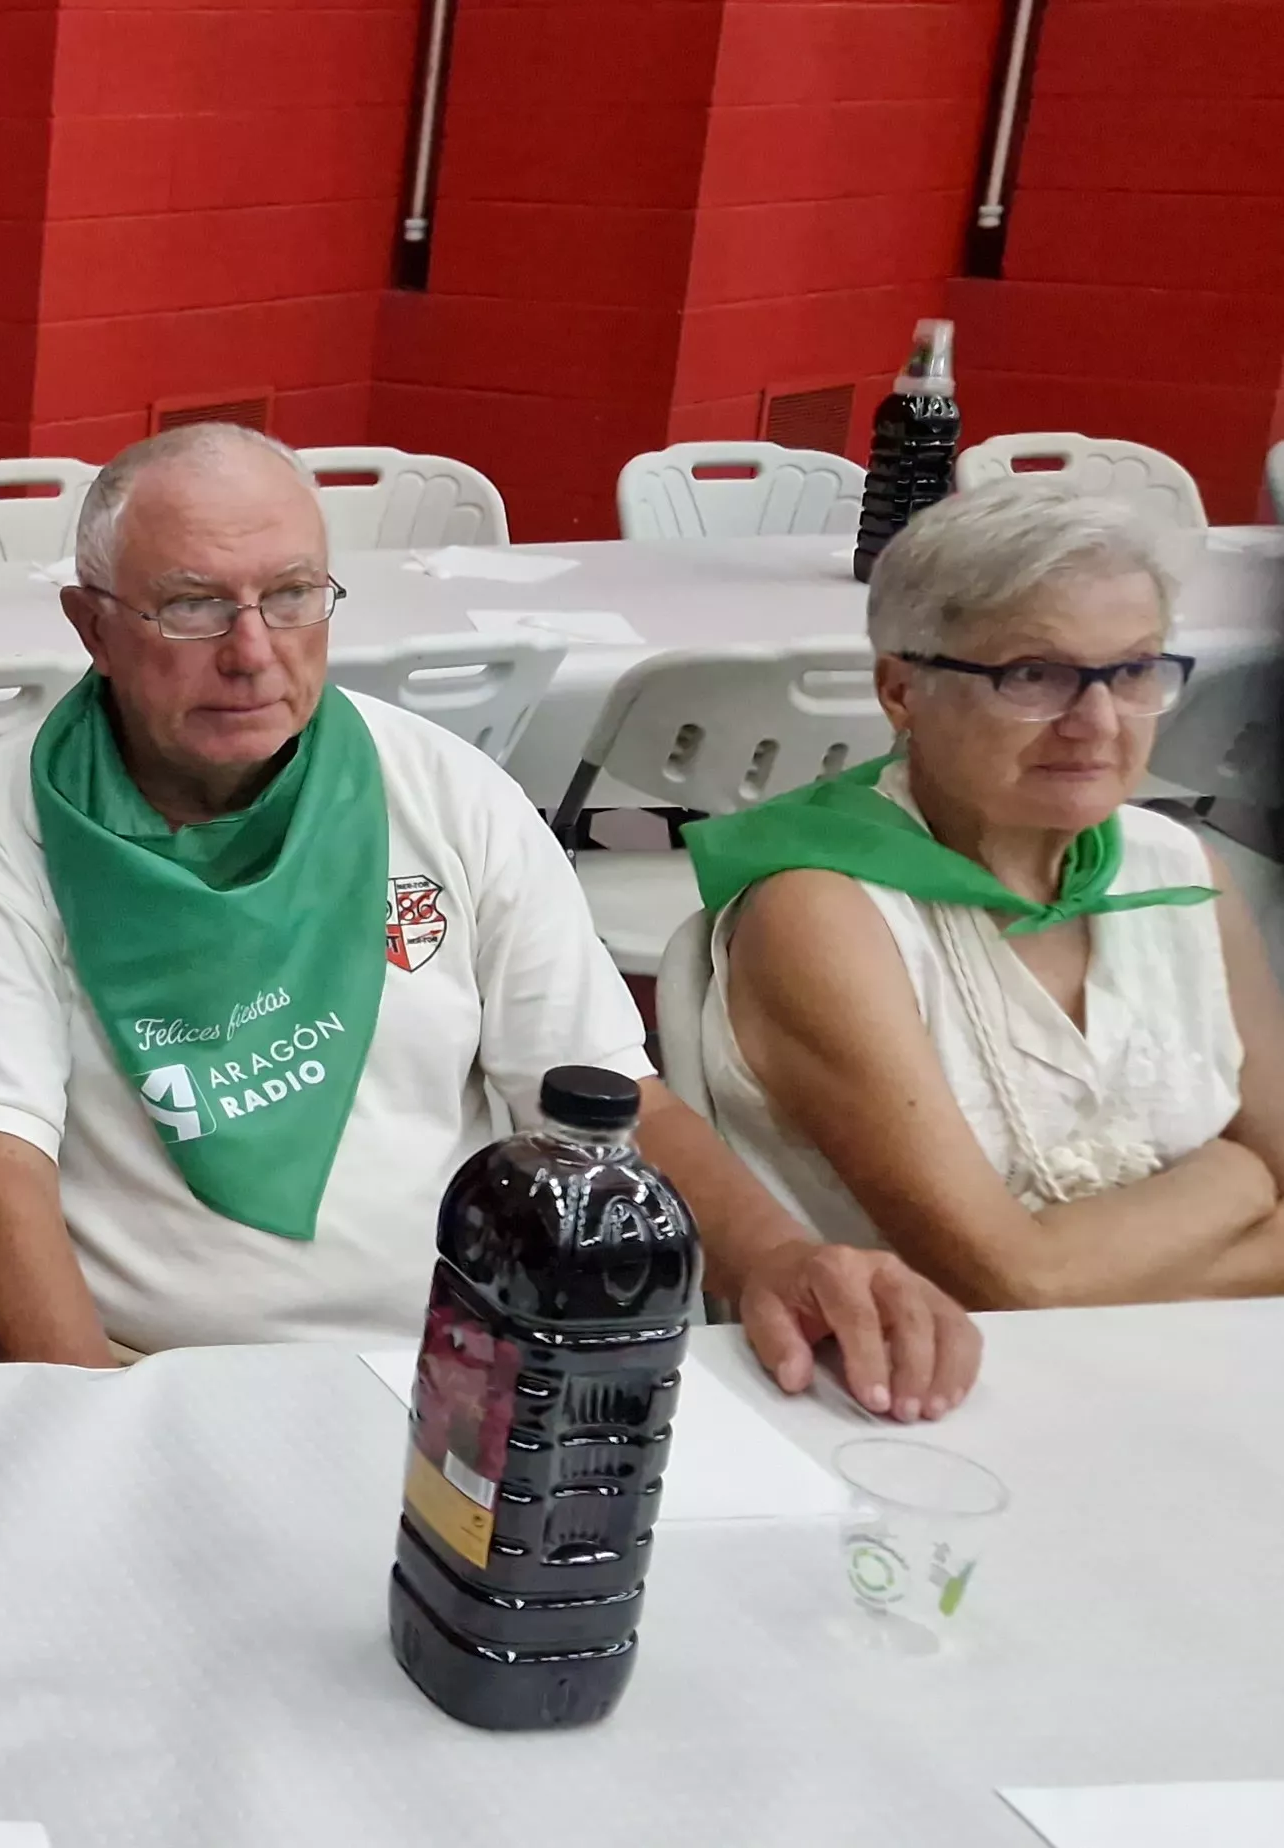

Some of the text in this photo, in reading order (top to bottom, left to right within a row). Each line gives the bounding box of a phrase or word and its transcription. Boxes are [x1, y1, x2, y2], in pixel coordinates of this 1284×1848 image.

[135, 986, 291, 1051] Felices fiestas
[210, 1012, 345, 1089] ARAGÓN
[219, 1060, 326, 1119] RADIO
